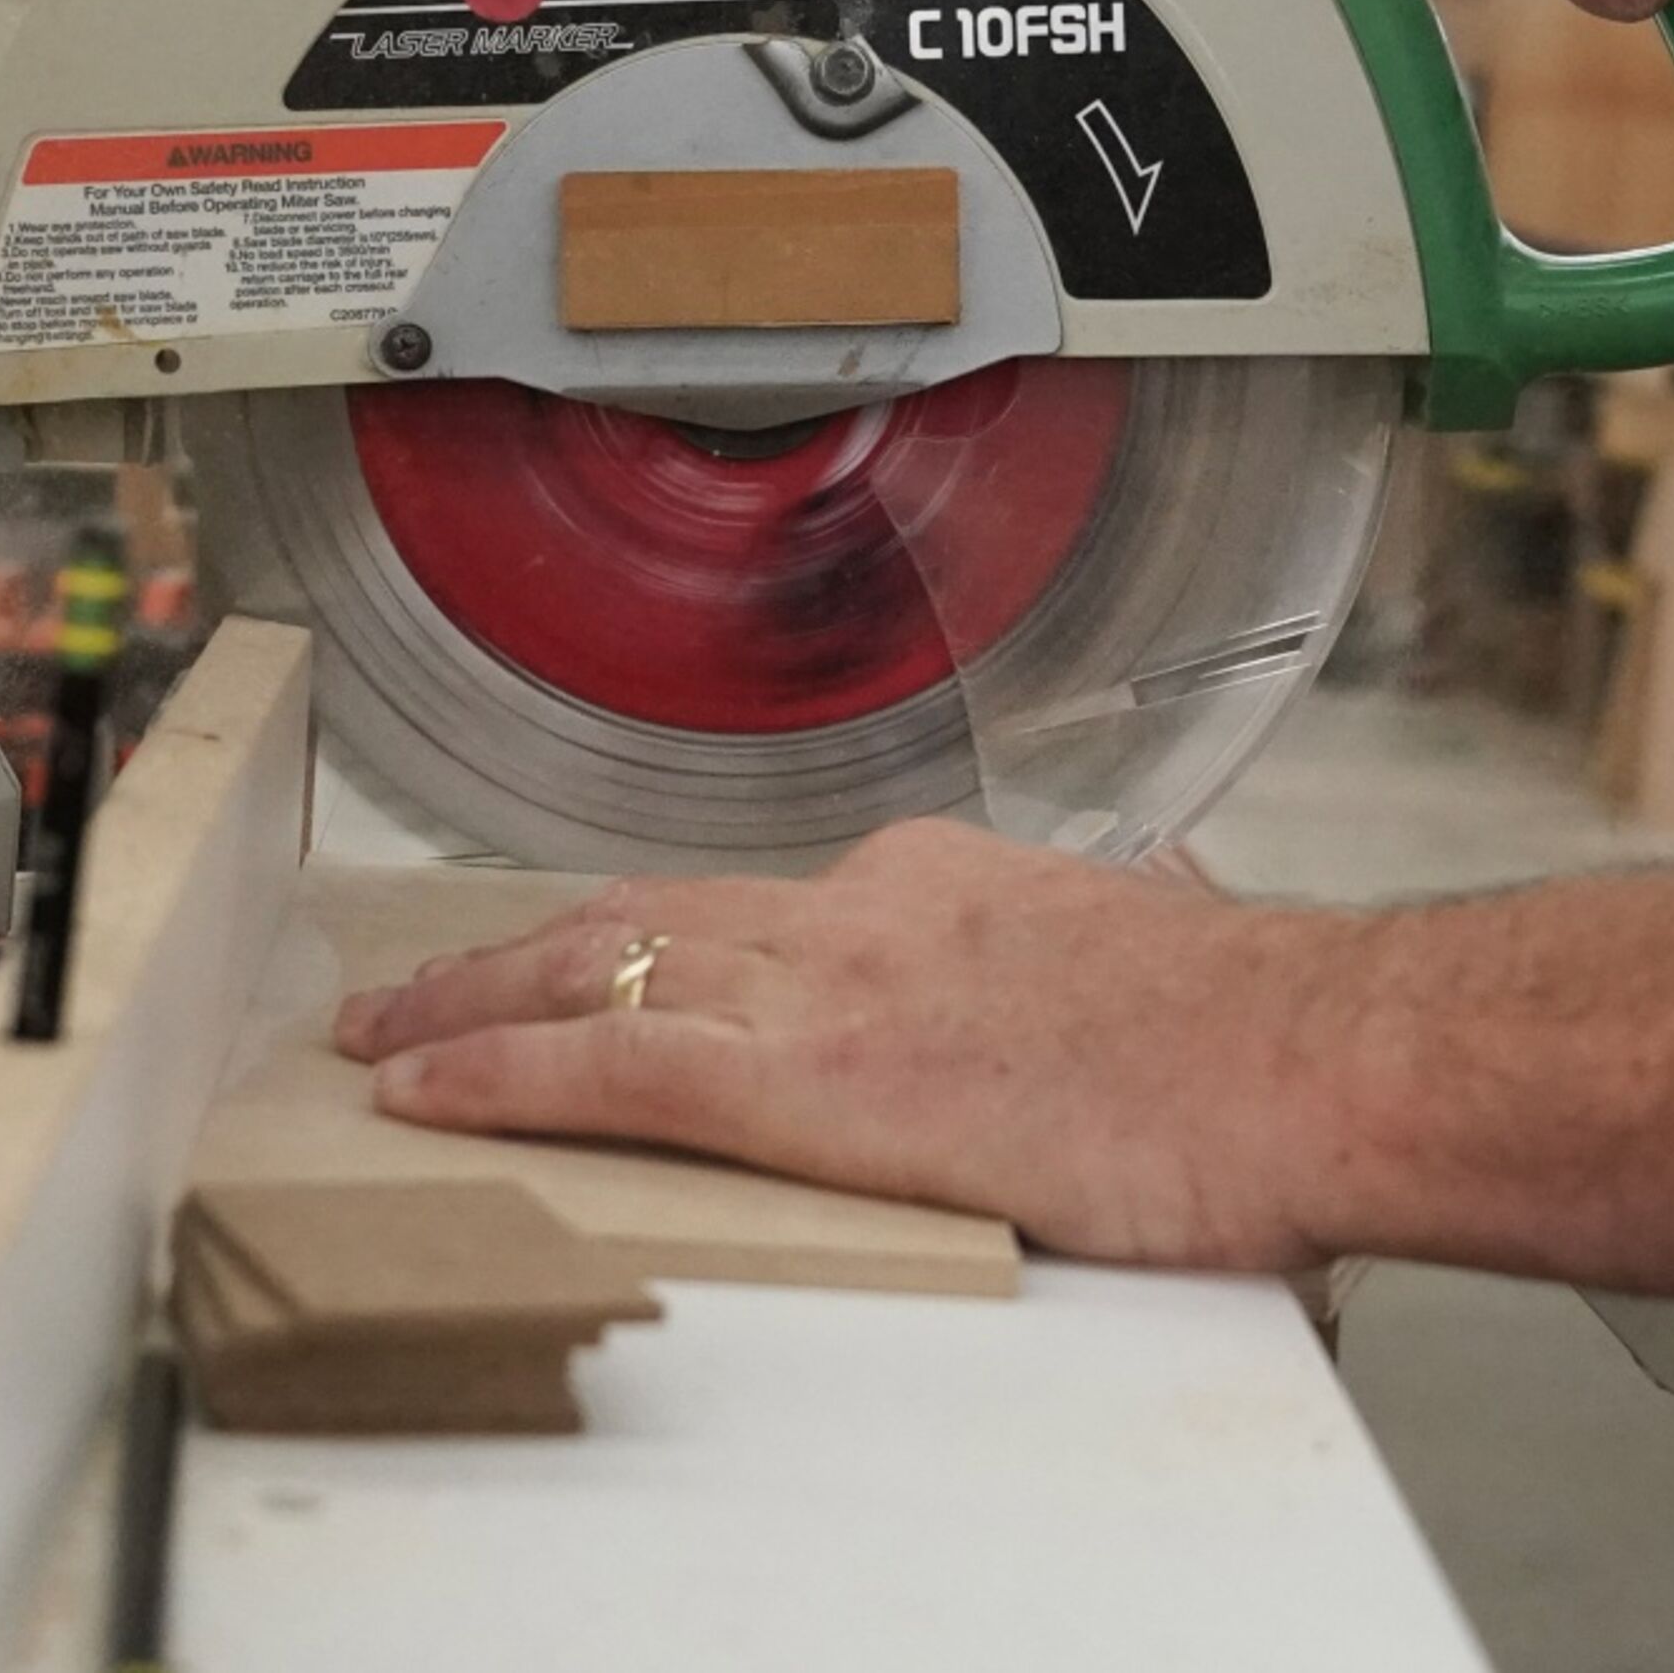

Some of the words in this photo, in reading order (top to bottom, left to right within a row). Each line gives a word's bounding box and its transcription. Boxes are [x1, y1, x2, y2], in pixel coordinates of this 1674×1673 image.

[909, 9, 943, 59] C
[956, 2, 1125, 58] 10FSH
[329, 28, 468, 59] LASER
[471, 23, 633, 54] MARKER
[189, 141, 313, 166] WARNING
[84, 186, 109, 199] For
[114, 185, 146, 198] Your
[151, 184, 186, 196] Own
[191, 180, 237, 196] Safety
[242, 178, 281, 193] Read
[286, 176, 365, 192] Instruction
[90, 201, 144, 217] Manual
[149, 199, 198, 214] Before
[204, 197, 276, 214] Operating
[281, 194, 318, 208] Miter
[324, 193, 359, 207] Saw.
[321, 211, 355, 222] power
[359, 208, 396, 219] before
[398, 206, 451, 219] changing
[51, 222, 72, 233] eye
[86, 232, 104, 242] out
[107, 230, 119, 242] of
[122, 230, 148, 243] path
[151, 228, 163, 240] of
[166, 229, 188, 239] saw
[253, 225, 285, 236] blade
[289, 225, 300, 234] or
[271, 235, 303, 247] blade
[306, 234, 355, 245] diameter
[31, 246, 49, 257] not
[53, 244, 97, 257] operate
[101, 244, 123, 254] saw
[127, 241, 170, 253] without
[258, 247, 283, 259] load
[286, 246, 323, 260] speed
[257, 260, 297, 272] reduce
[300, 258, 319, 270] the
[322, 257, 341, 268] risk
[345, 256, 356, 267] of
[46, 269, 91, 283] perform
[96, 268, 115, 281] any
[119, 266, 174, 279] operation
[241, 273, 275, 285] return
[278, 271, 325, 284] carriage
[329, 270, 340, 281] to
[343, 269, 362, 280] the
[235, 285, 282, 298] position
[284, 283, 311, 296] after
[314, 282, 342, 294] each
[124, 314, 183, 327] workpiece
